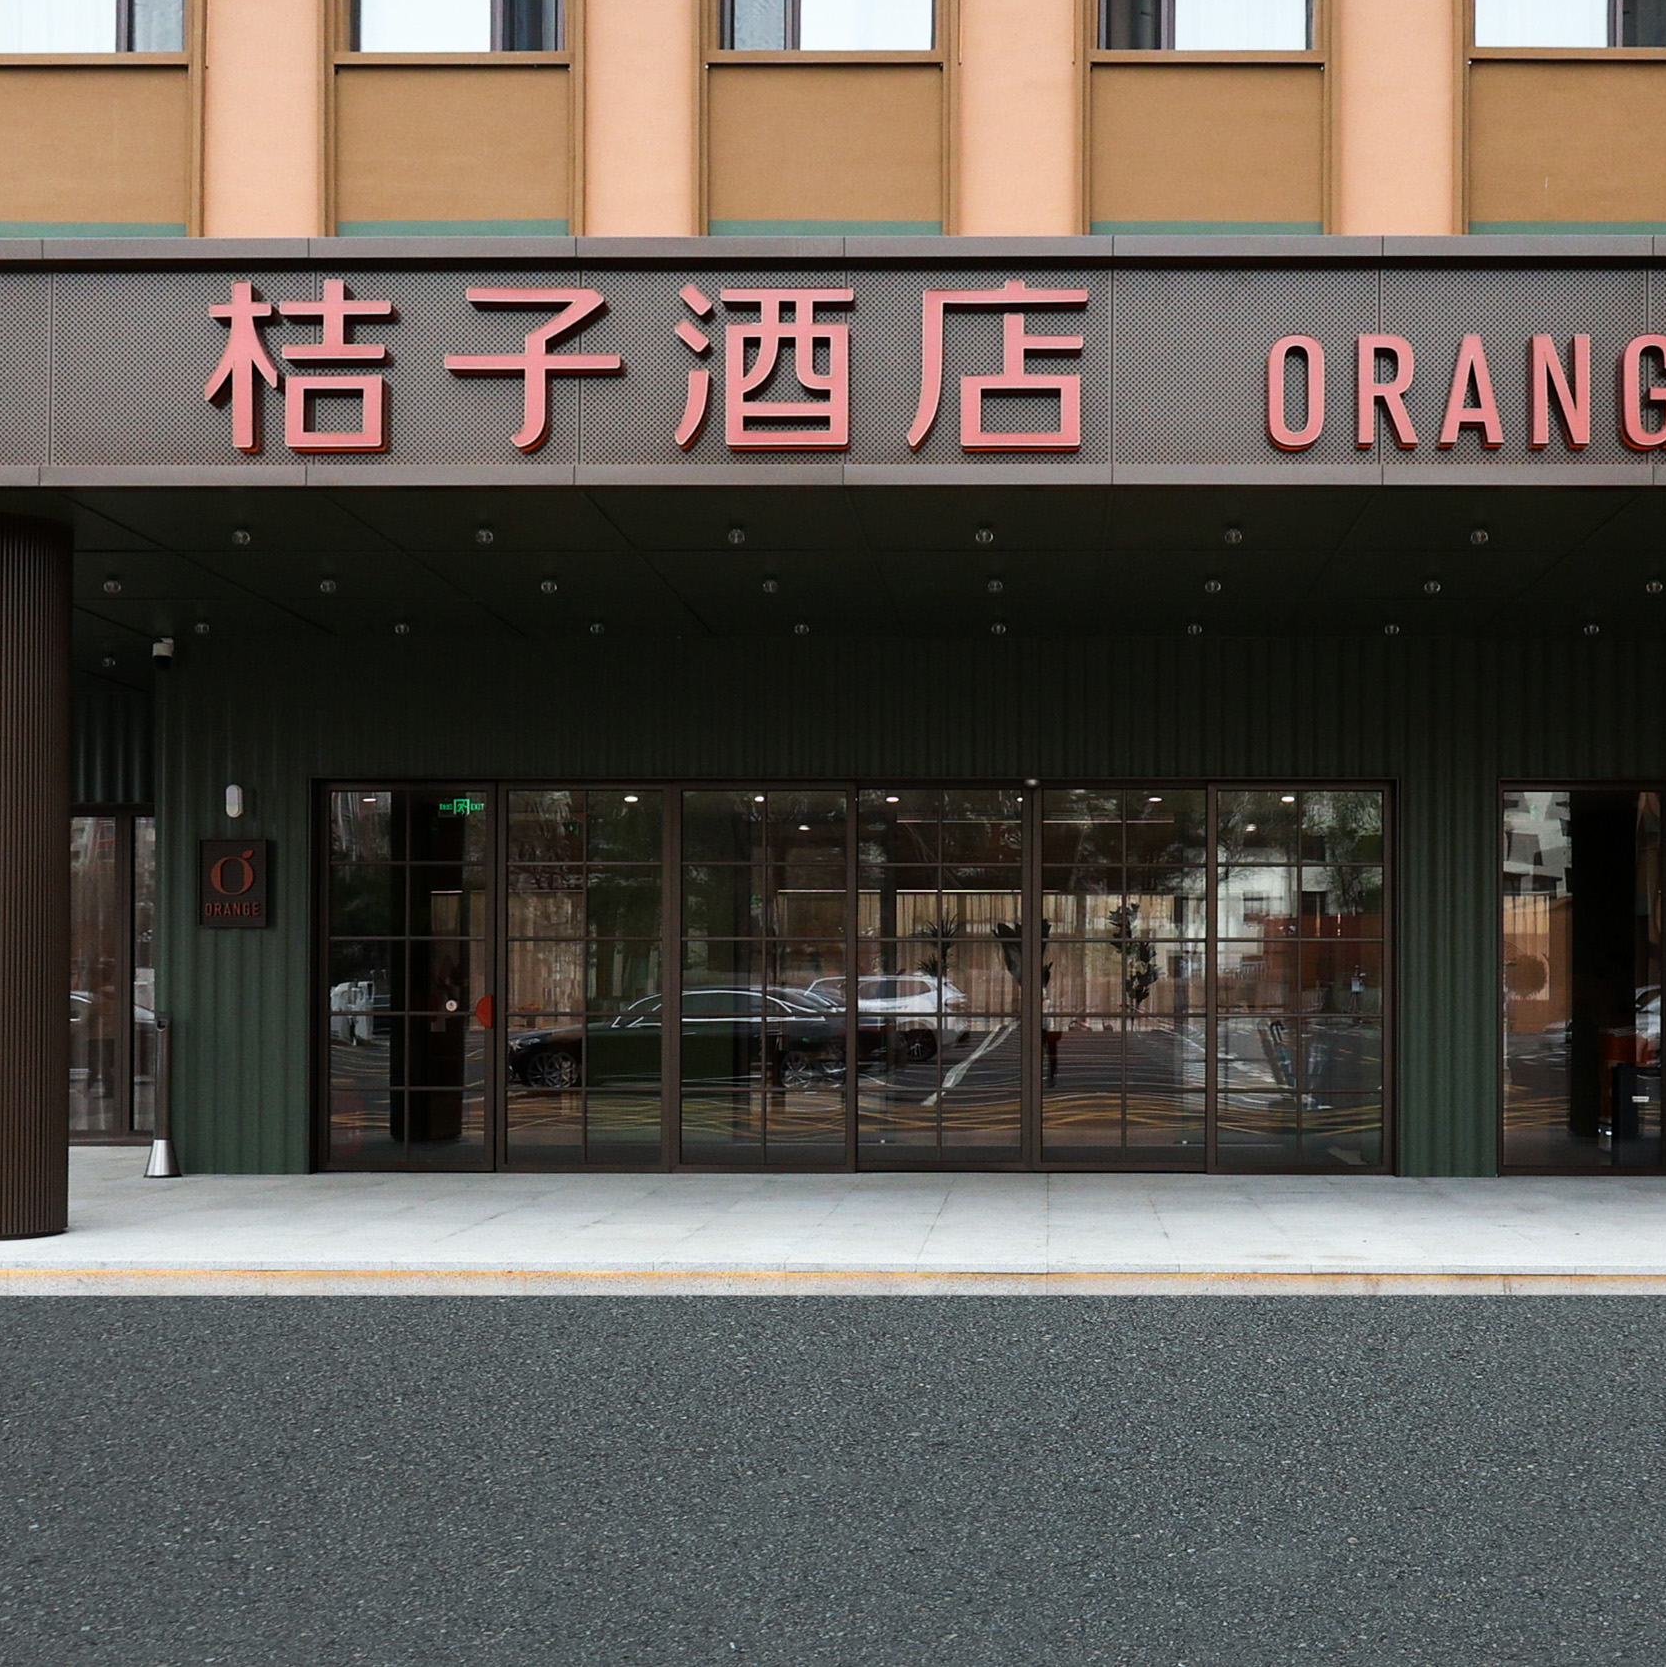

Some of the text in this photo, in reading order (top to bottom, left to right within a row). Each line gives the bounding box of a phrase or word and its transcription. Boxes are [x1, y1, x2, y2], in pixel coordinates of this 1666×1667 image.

[205, 279, 1090, 453] 桔子酒店
[205, 902, 261, 916] ORANGE
